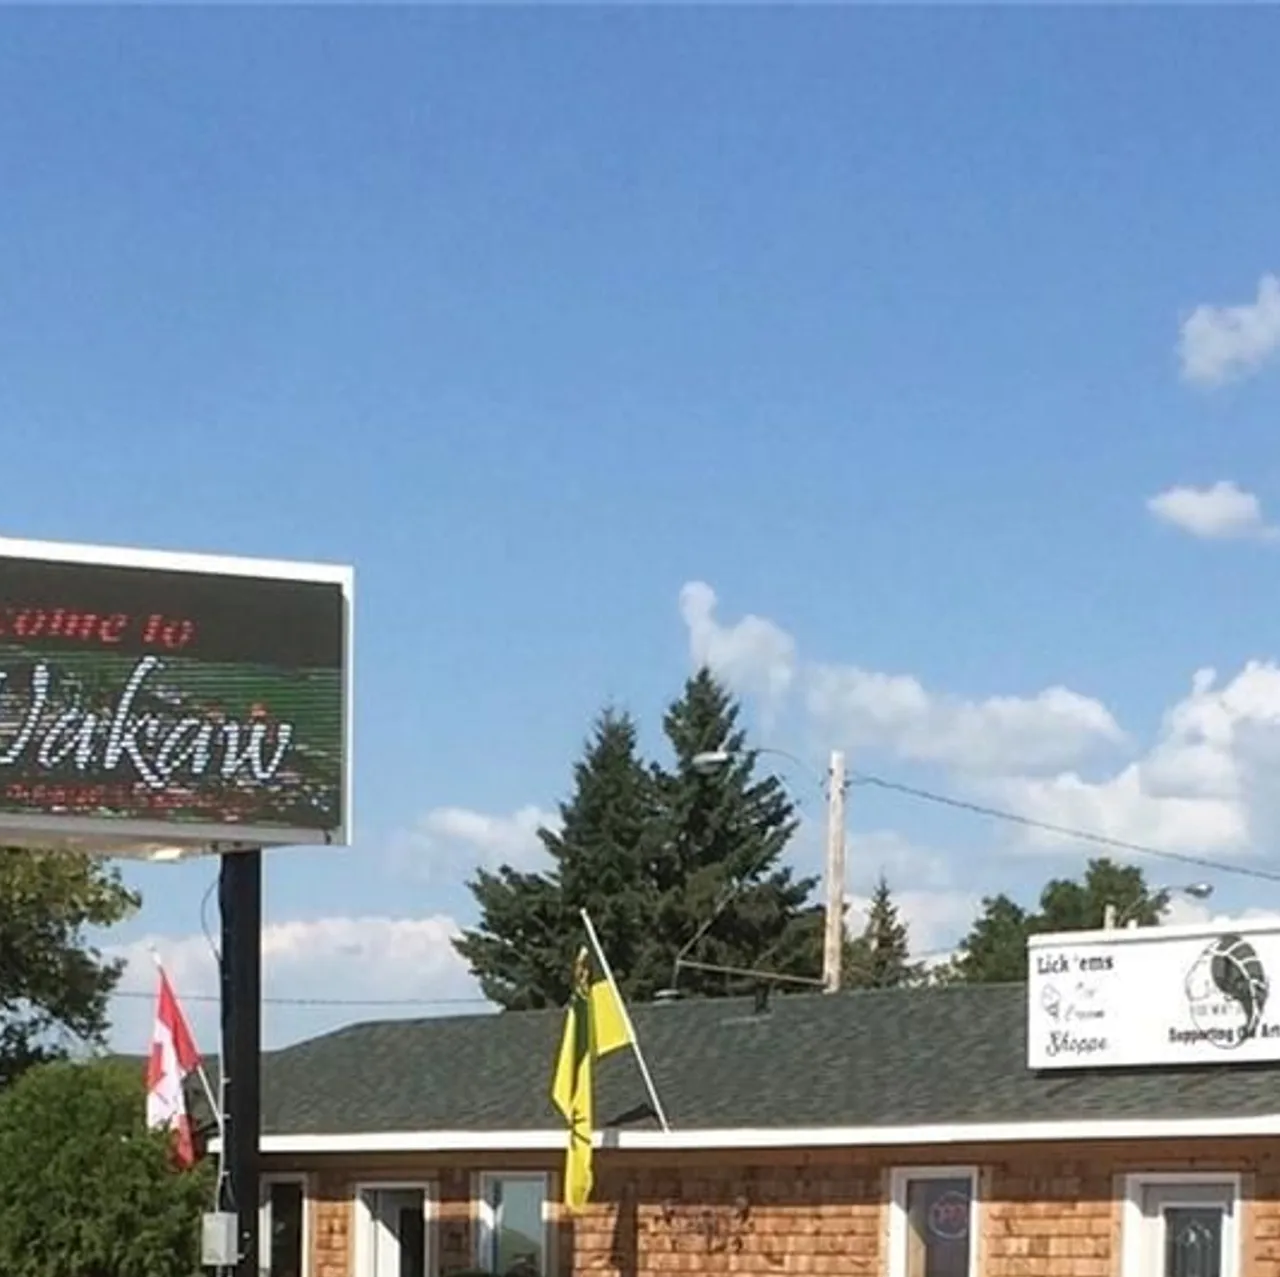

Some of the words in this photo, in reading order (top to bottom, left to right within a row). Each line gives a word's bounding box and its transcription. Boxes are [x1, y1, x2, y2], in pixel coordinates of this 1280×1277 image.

[1036, 953, 1070, 975] Lick
[1045, 1029, 1109, 1058] Shoppe
[1168, 1026, 1234, 1045] Supporting
